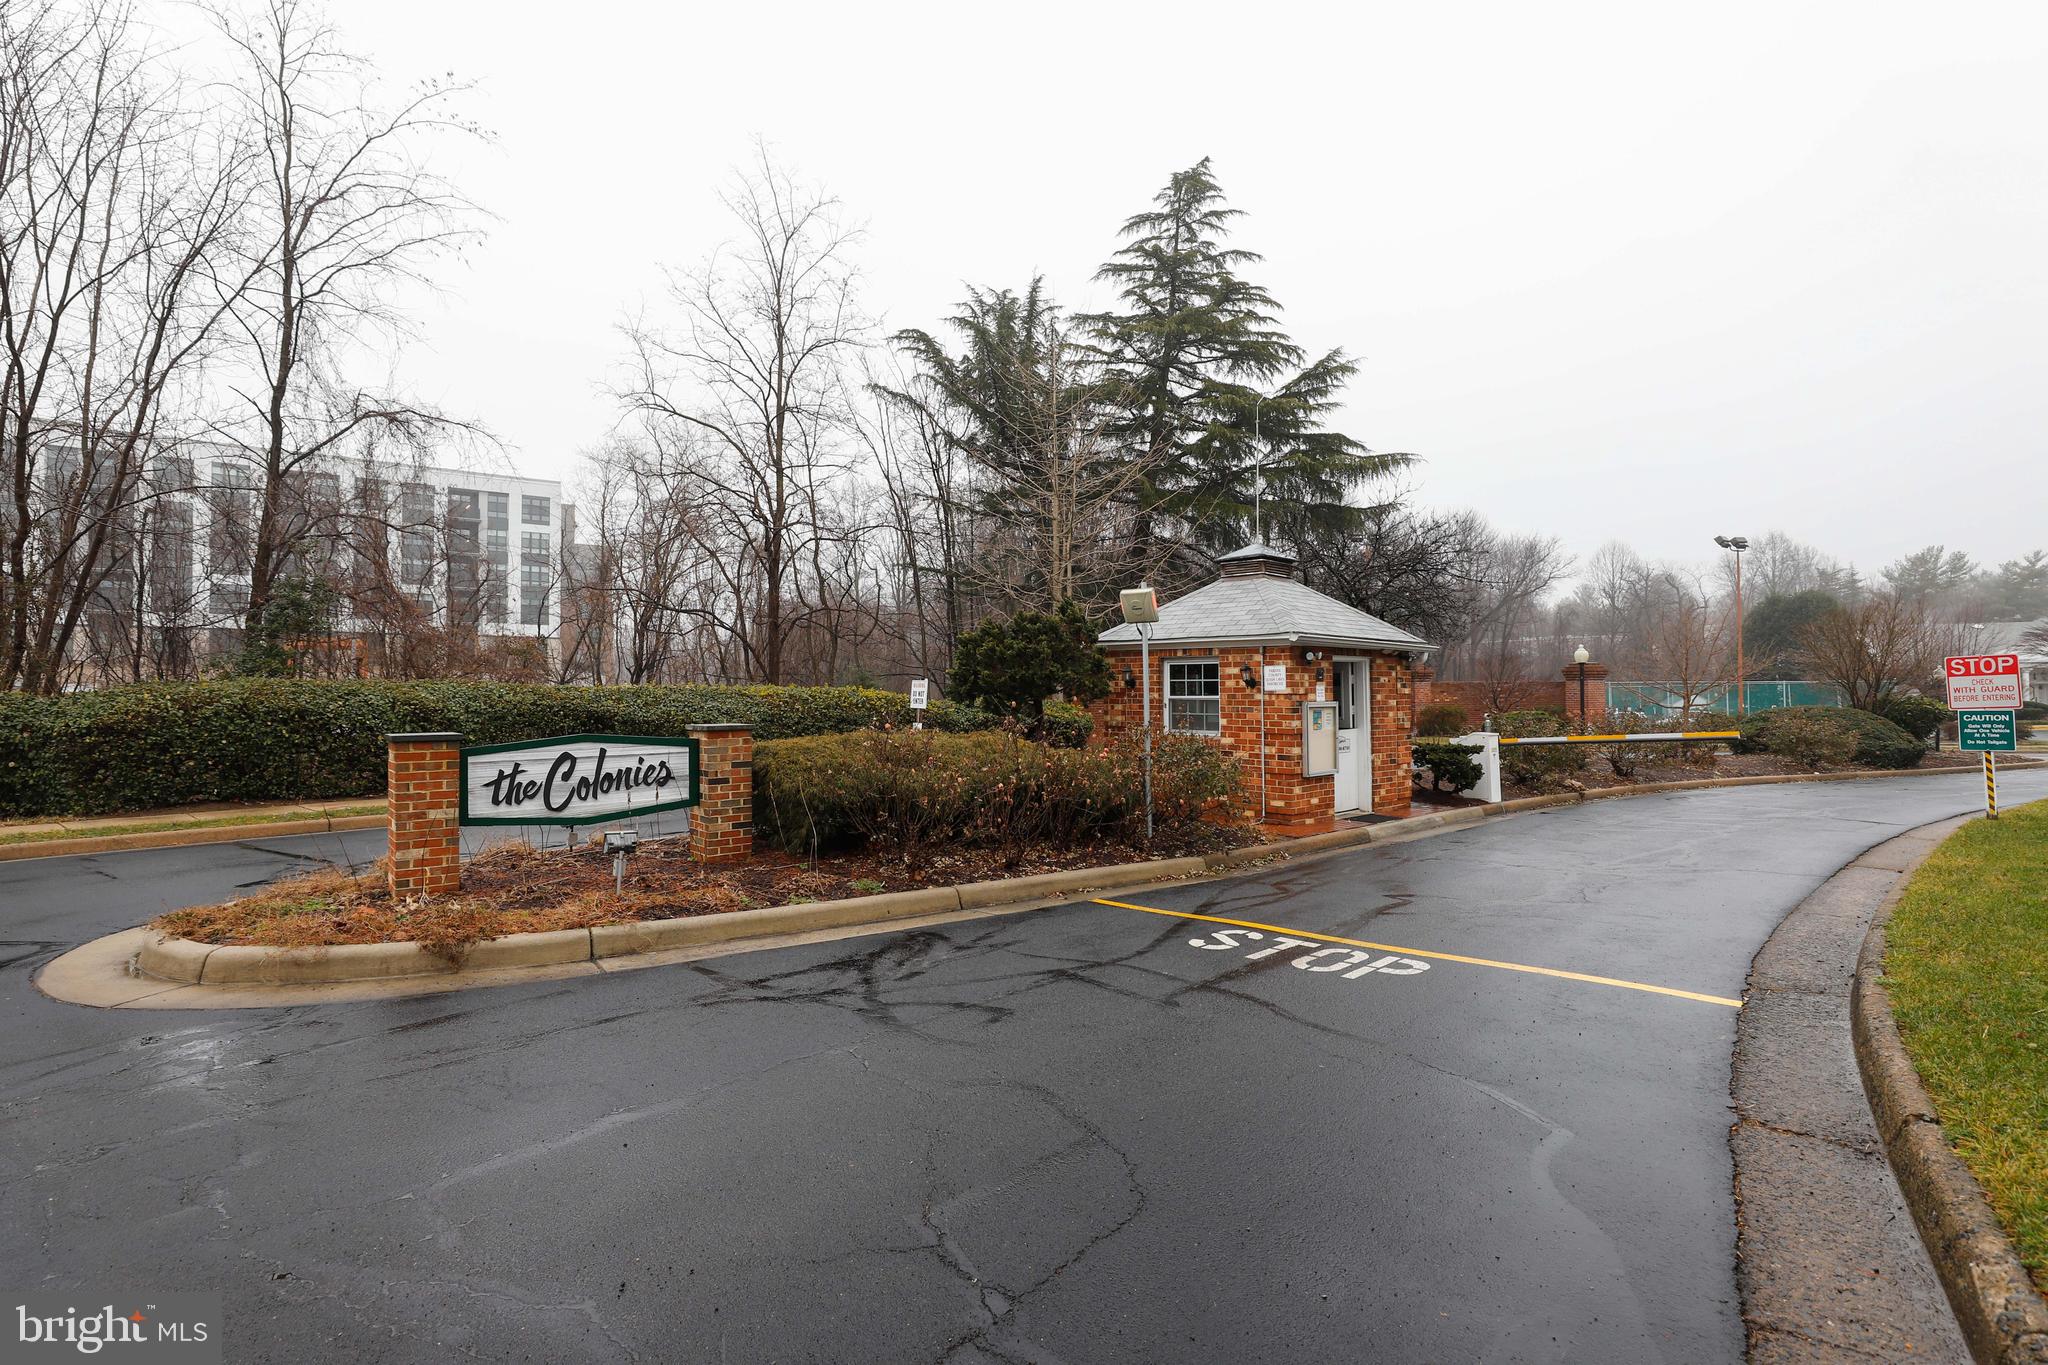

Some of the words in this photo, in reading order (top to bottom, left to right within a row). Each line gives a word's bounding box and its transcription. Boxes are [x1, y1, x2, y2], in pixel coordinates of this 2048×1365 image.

[1950, 657, 2014, 675] STOP
[1971, 678, 1994, 686] CHECK
[1953, 686, 1976, 694] WITH
[1980, 685, 2015, 693] GUARD
[1982, 693, 2016, 702] ENTERING
[481, 762, 544, 807] the
[543, 747, 676, 812] Colonies
[1188, 929, 1431, 980] STOP
